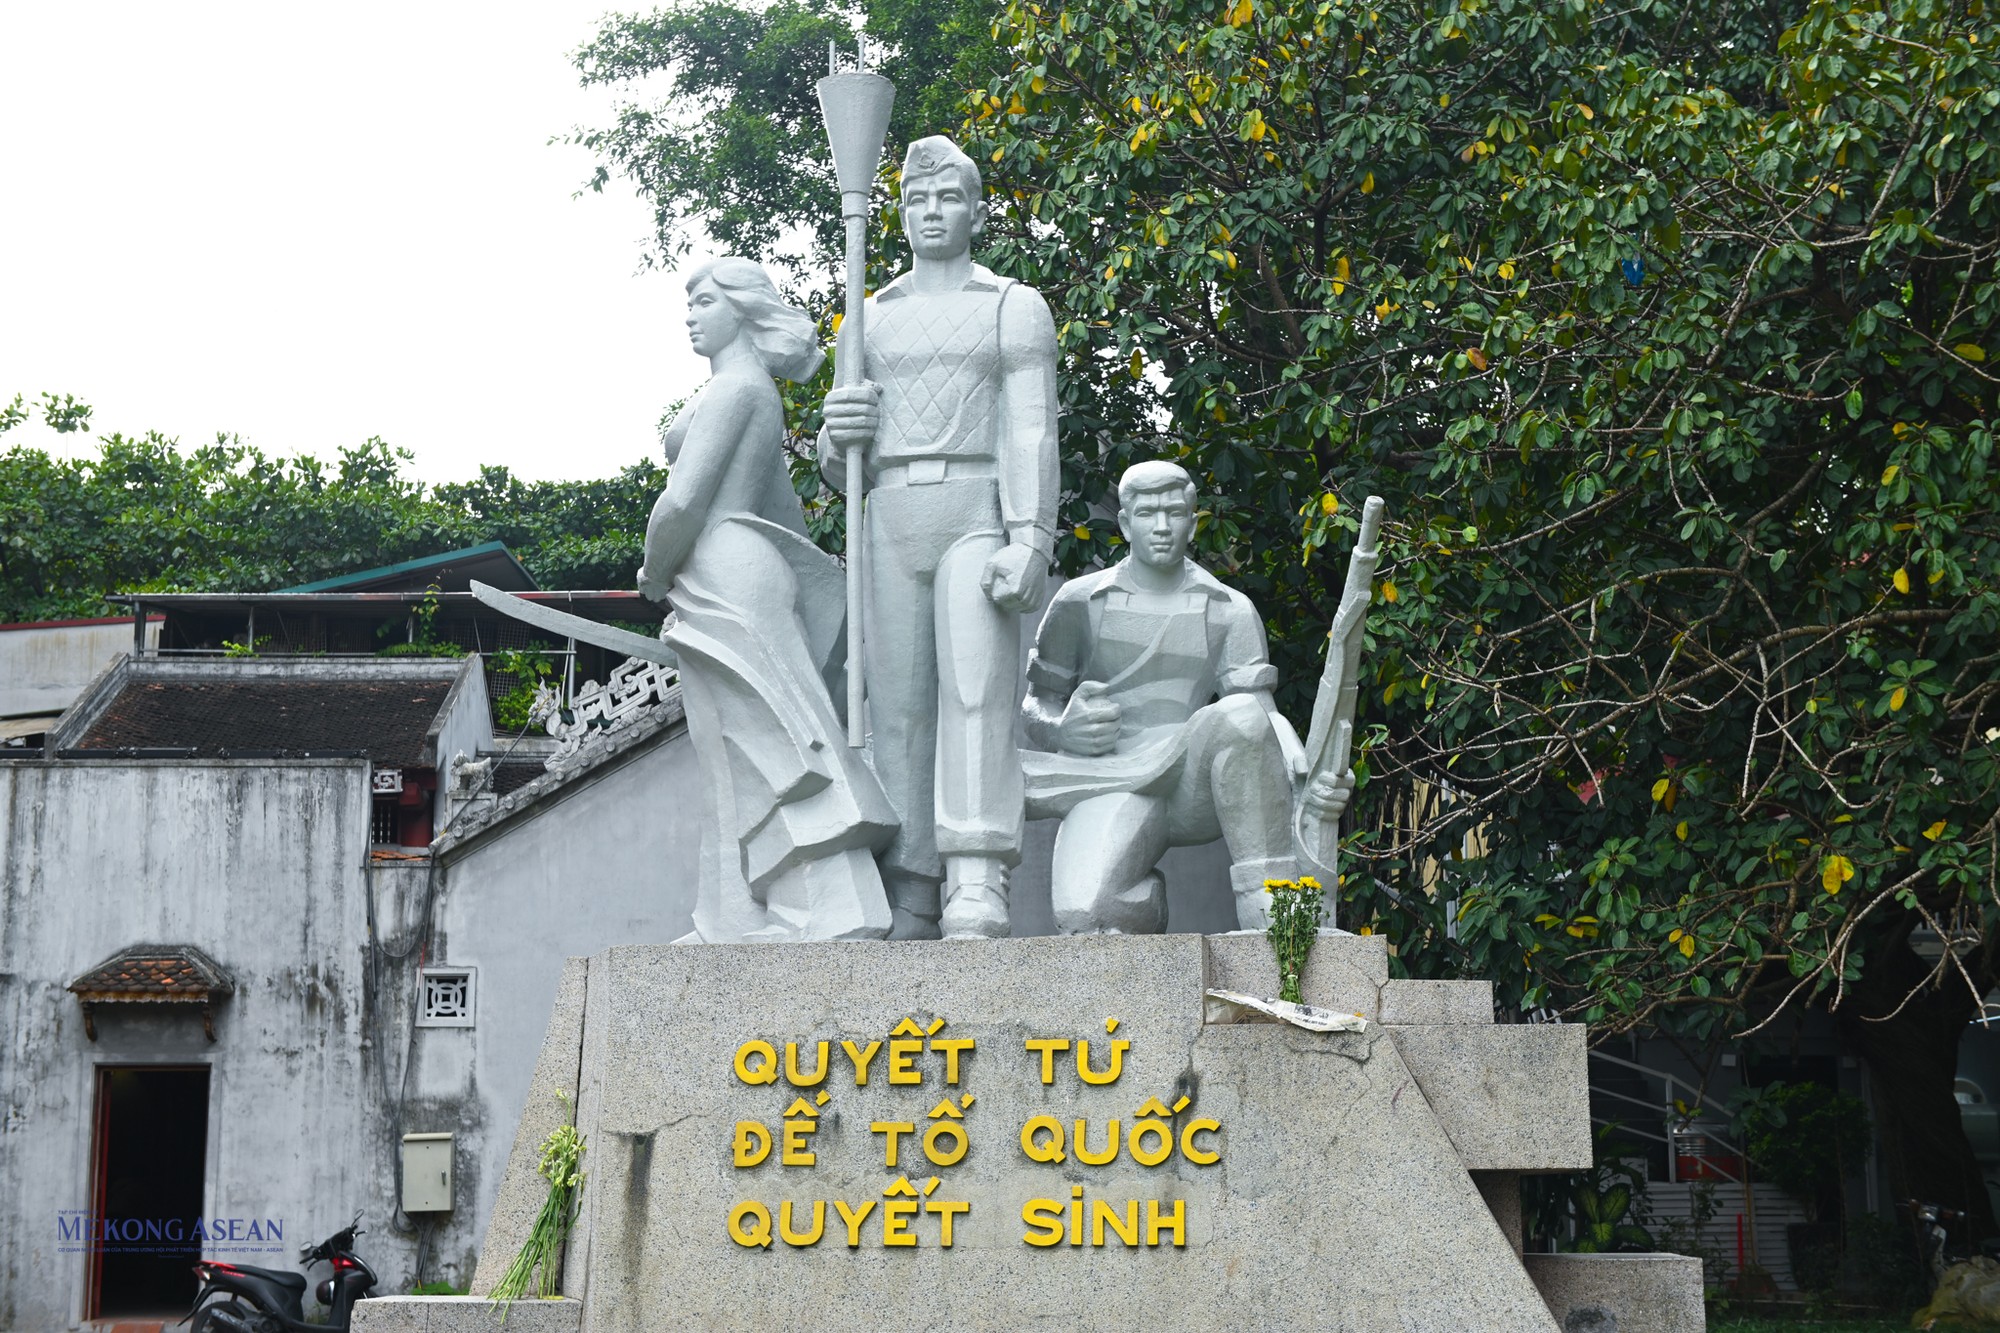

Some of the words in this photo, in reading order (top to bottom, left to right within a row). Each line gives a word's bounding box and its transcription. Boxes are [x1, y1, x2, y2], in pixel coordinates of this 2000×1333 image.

[733, 1017, 975, 1086] QUYẾT
[1026, 1018, 1130, 1084] TỬ
[732, 1090, 831, 1167] ĐỂ
[871, 1093, 975, 1167] TỔ
[1021, 1095, 1220, 1166] QUỐC
[728, 1176, 970, 1248] QUYẾT
